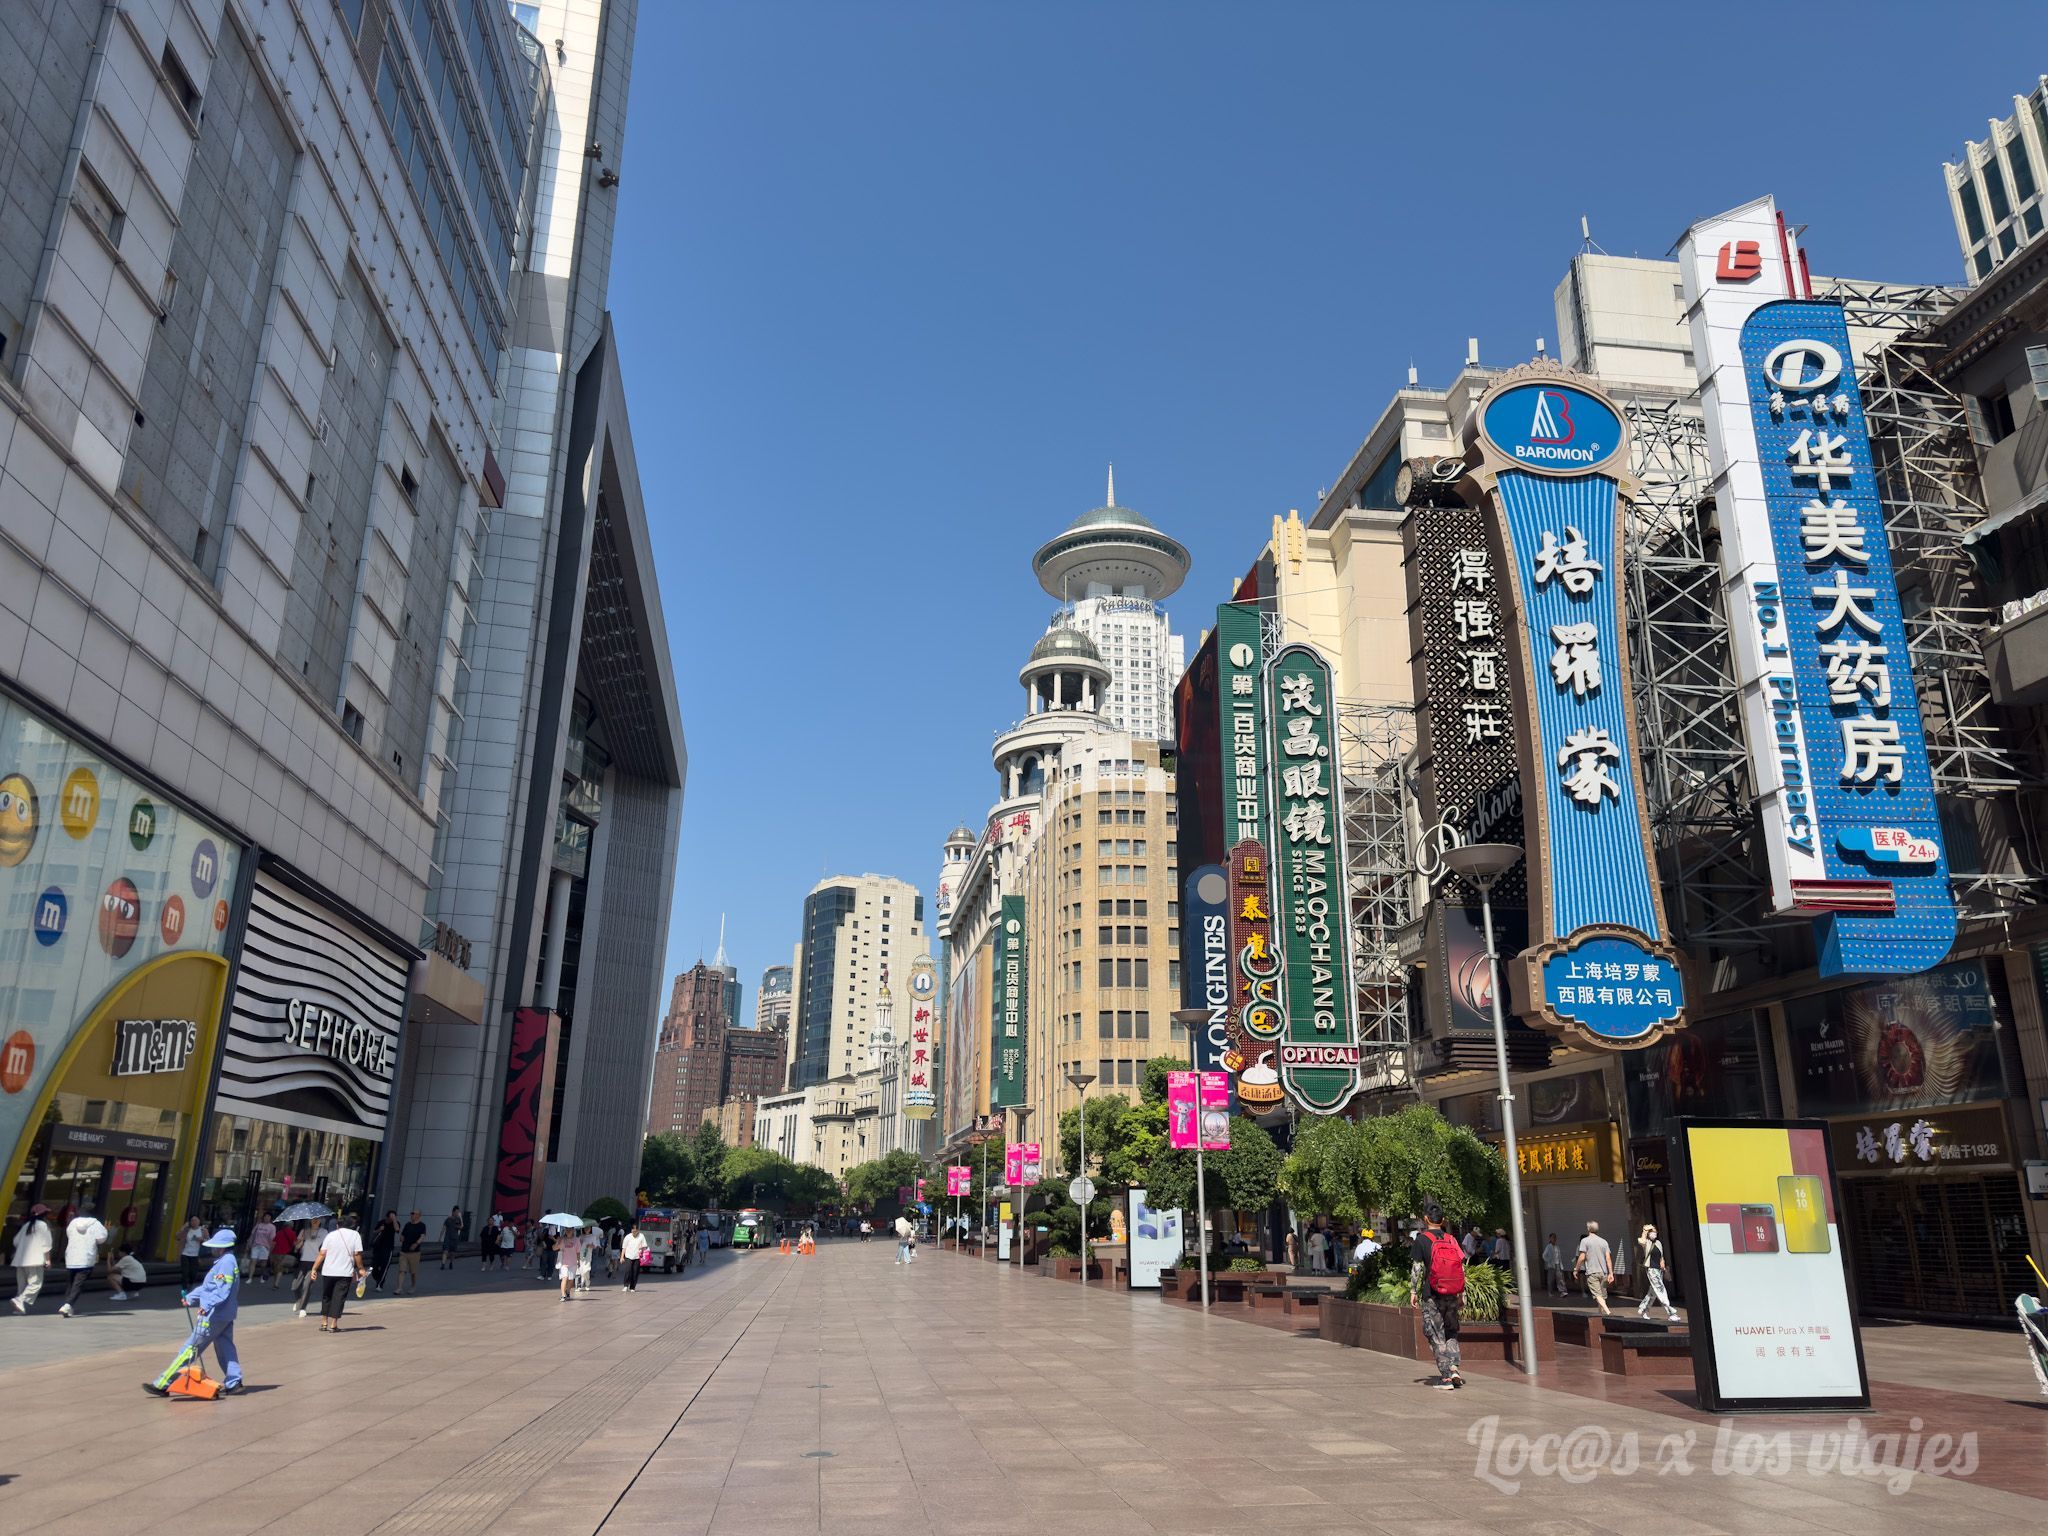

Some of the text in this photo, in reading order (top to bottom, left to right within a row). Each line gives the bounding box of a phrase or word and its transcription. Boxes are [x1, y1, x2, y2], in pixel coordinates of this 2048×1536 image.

[1515, 445, 1594, 462] BAROMON
[1095, 596, 1153, 615] Radisson
[1787, 429, 1907, 783] 华美大药房
[1753, 581, 1816, 858] No.1 Pharmacy
[1232, 674, 1258, 840] 第一百货商业中心
[1280, 673, 1332, 844] 茂昌眼镜
[68, 784, 92, 822] m
[134, 810, 151, 838] m
[1875, 831, 1907, 846] 医保
[1908, 845, 1935, 858] 24H
[196, 853, 213, 884] m
[1291, 849, 1306, 933] SINCE 1923
[41, 901, 61, 931] m
[166, 907, 180, 933] m
[1305, 850, 1336, 1029] MAOCHANG
[1565, 961, 1661, 982] 上海培罗蒙
[1005, 938, 1019, 1038] 第一百货商业中心
[1204, 915, 1229, 1064] LONGINES
[1558, 986, 1673, 1006] 西服有限公司
[284, 999, 388, 1075] SEPHORA
[911, 1006, 930, 1088] 新世界城
[6, 1046, 28, 1076] m
[1283, 1047, 1358, 1063] OPTICAL
[1795, 1189, 1806, 1198] 16
[1796, 1199, 1807, 1208] 10
[1735, 1326, 1775, 1335] HUAWEI
[1778, 1326, 1797, 1335] Pura
[1800, 1326, 1806, 1334] X
[1776, 1346, 1816, 1357] 很有型
